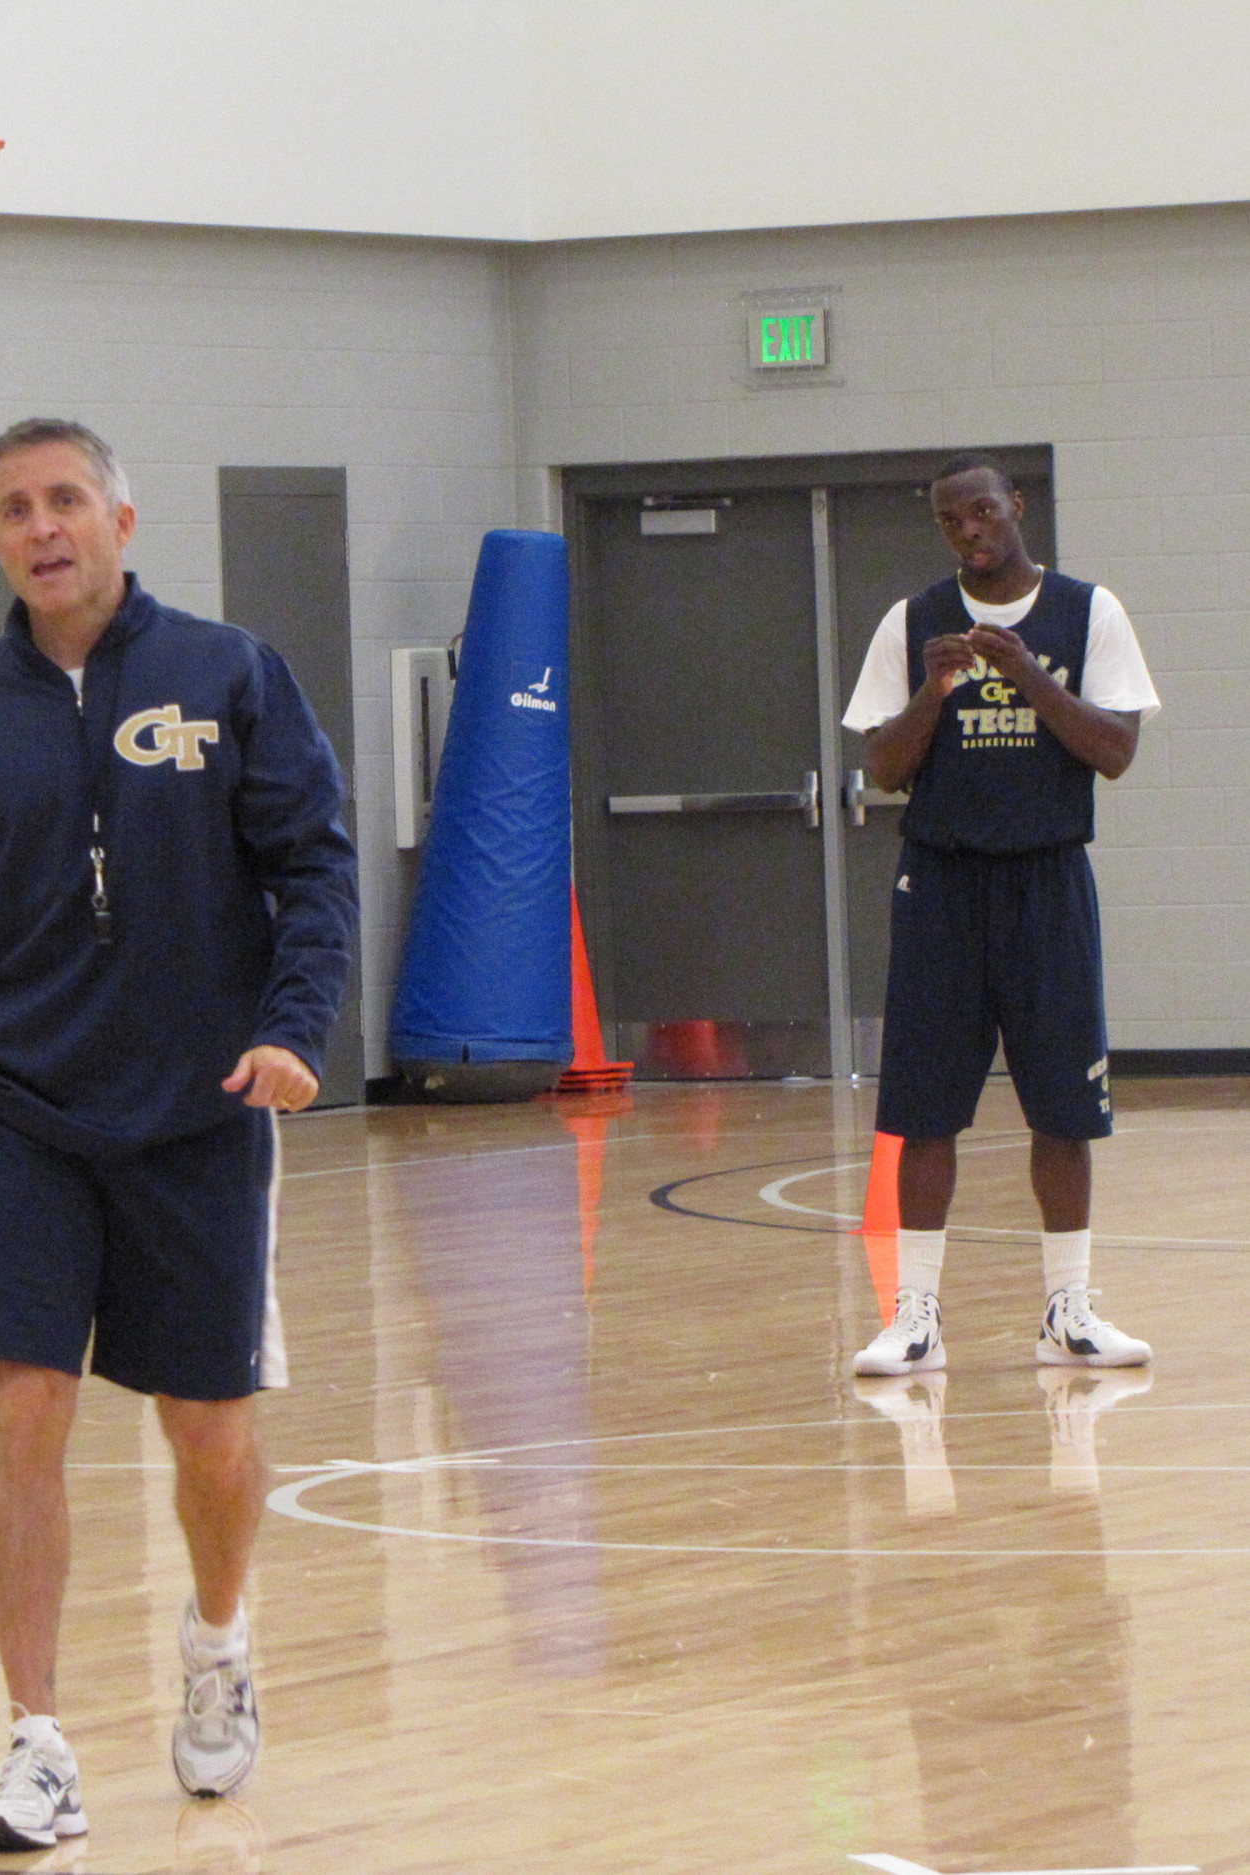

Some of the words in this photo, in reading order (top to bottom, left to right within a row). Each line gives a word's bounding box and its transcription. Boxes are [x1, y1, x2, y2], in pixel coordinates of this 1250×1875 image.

[761, 316, 815, 362] EXIT
[510, 693, 556, 712] Gilman
[980, 681, 1017, 704] GT
[957, 708, 1037, 735] TECH
[113, 704, 220, 771] GT
[961, 737, 1036, 749] BASKETBALL
